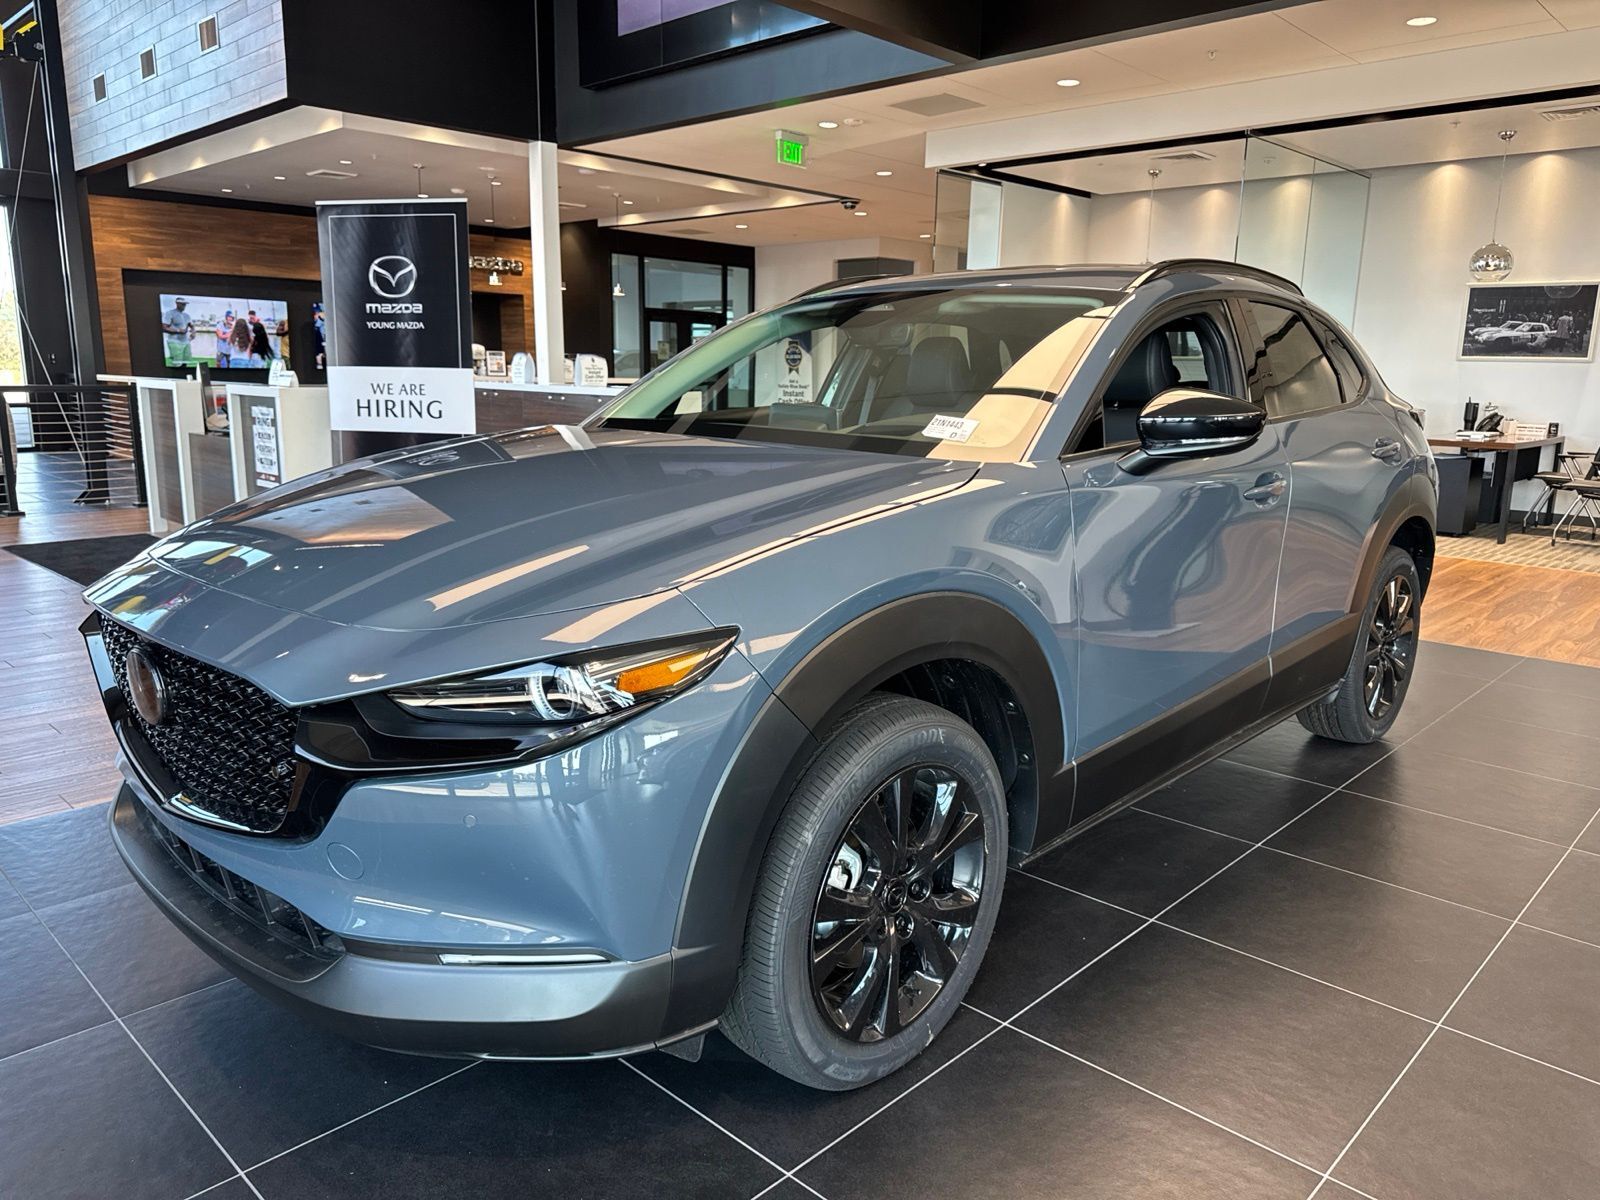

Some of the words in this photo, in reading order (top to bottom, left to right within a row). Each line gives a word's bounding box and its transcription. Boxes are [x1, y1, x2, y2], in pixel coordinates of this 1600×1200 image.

[783, 141, 803, 164] EXIT
[366, 303, 423, 314] mazda
[366, 321, 395, 330] YOUNG
[396, 321, 425, 330] MAZDA
[370, 383, 394, 395] WE
[399, 383, 426, 396] ARE
[356, 399, 443, 419] HIRING
